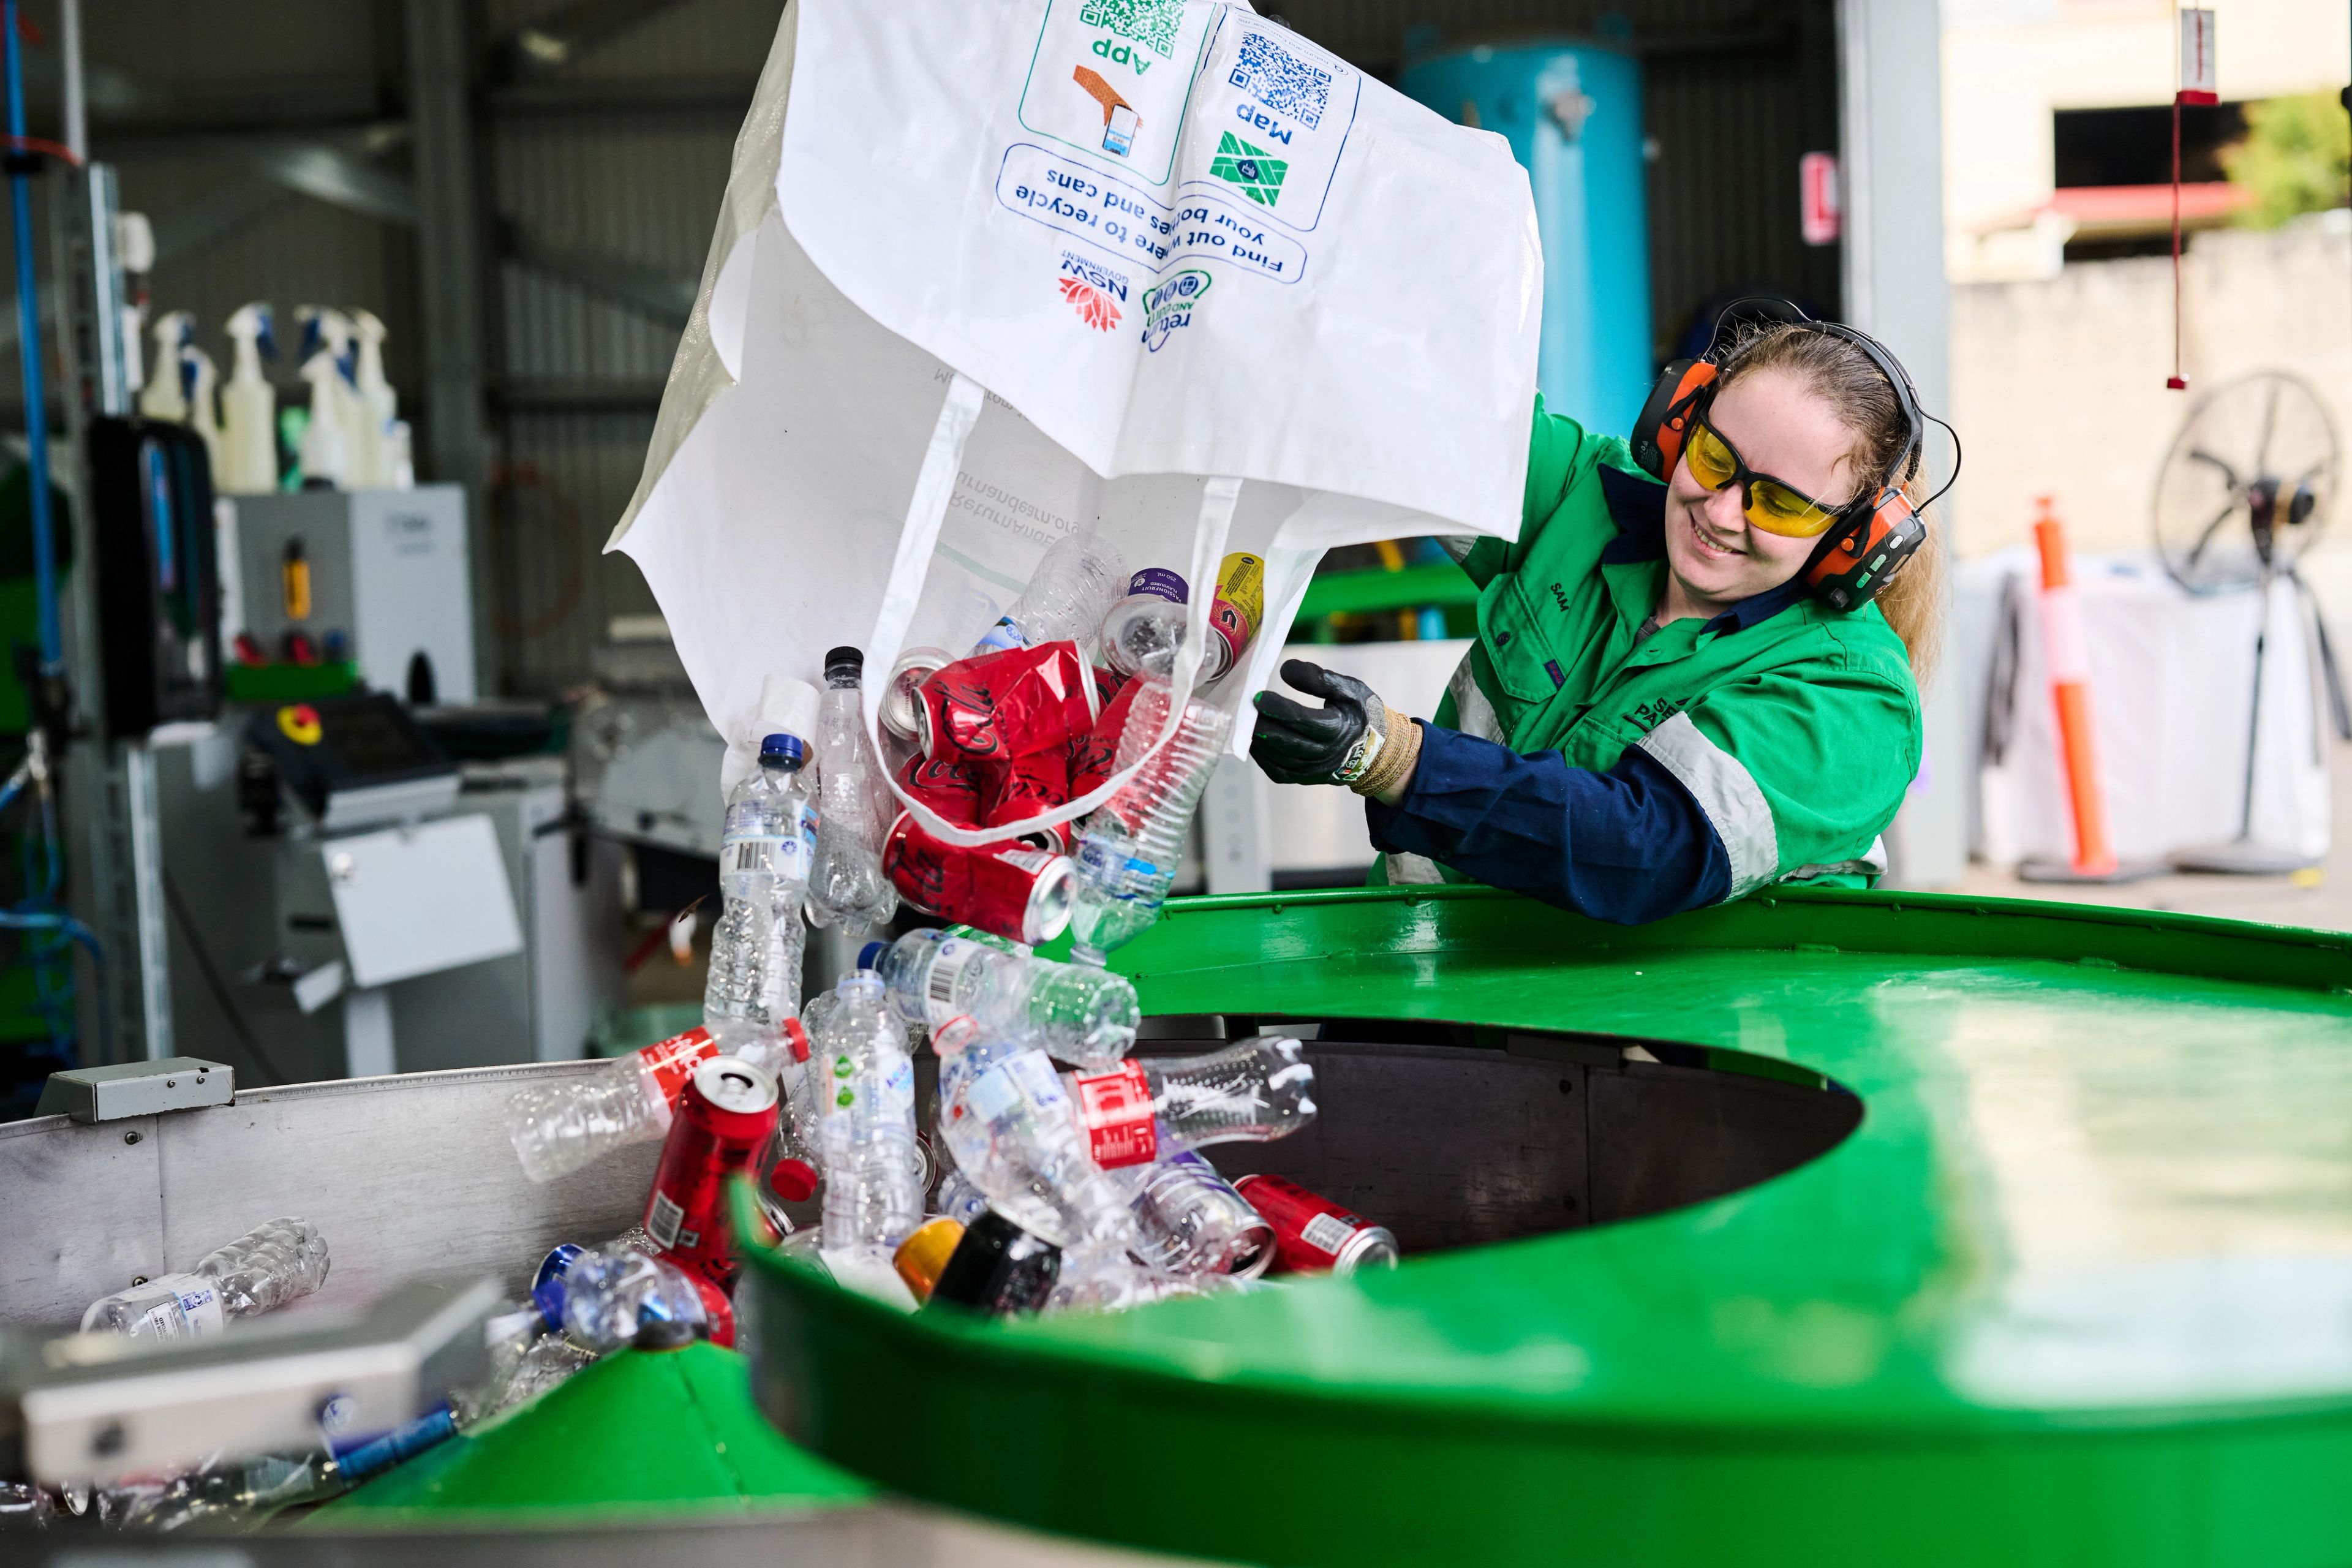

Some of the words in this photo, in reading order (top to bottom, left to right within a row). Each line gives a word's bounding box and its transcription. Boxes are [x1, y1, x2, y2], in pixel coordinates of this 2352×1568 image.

[1093, 39, 1153, 76] App
[1236, 102, 1293, 146] Map
[1047, 169, 1098, 198] cans
[1016, 185, 1098, 228] recycle
[1103, 192, 1146, 219] and
[1105, 221, 1128, 237] to
[1150, 208, 1209, 234] bottles
[1216, 214, 1265, 246] your
[1136, 234, 1181, 260] where
[1186, 232, 1226, 246] out
[1061, 249, 1129, 285] GOVERNMENT
[1232, 245, 1284, 273] Find
[1061, 260, 1128, 303] NSW
[1172, 302, 1195, 313] AND
[1141, 312, 1191, 344] return
[1141, 586, 1182, 603] PASSIONFRUIT
[1150, 581, 1178, 594] FLAVOURED
[1550, 582, 1569, 612] SAM
[1654, 697, 1679, 723] SE
